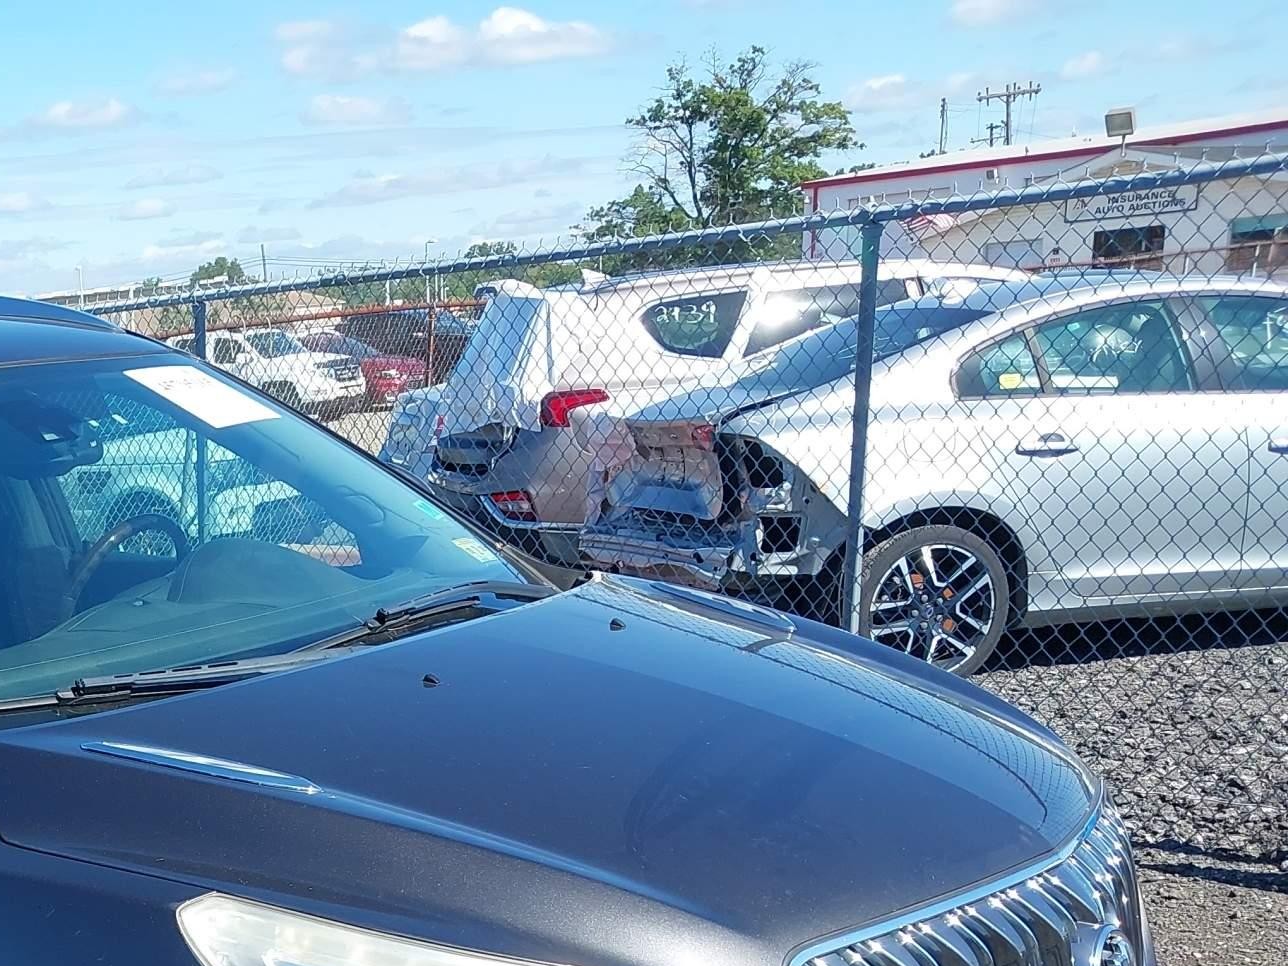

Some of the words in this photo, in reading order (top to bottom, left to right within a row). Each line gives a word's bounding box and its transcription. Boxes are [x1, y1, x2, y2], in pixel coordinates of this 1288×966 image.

[1107, 189, 1176, 204] INSURANCE
[1094, 203, 1124, 215] AUTO
[1128, 198, 1186, 212] AUCTIONS
